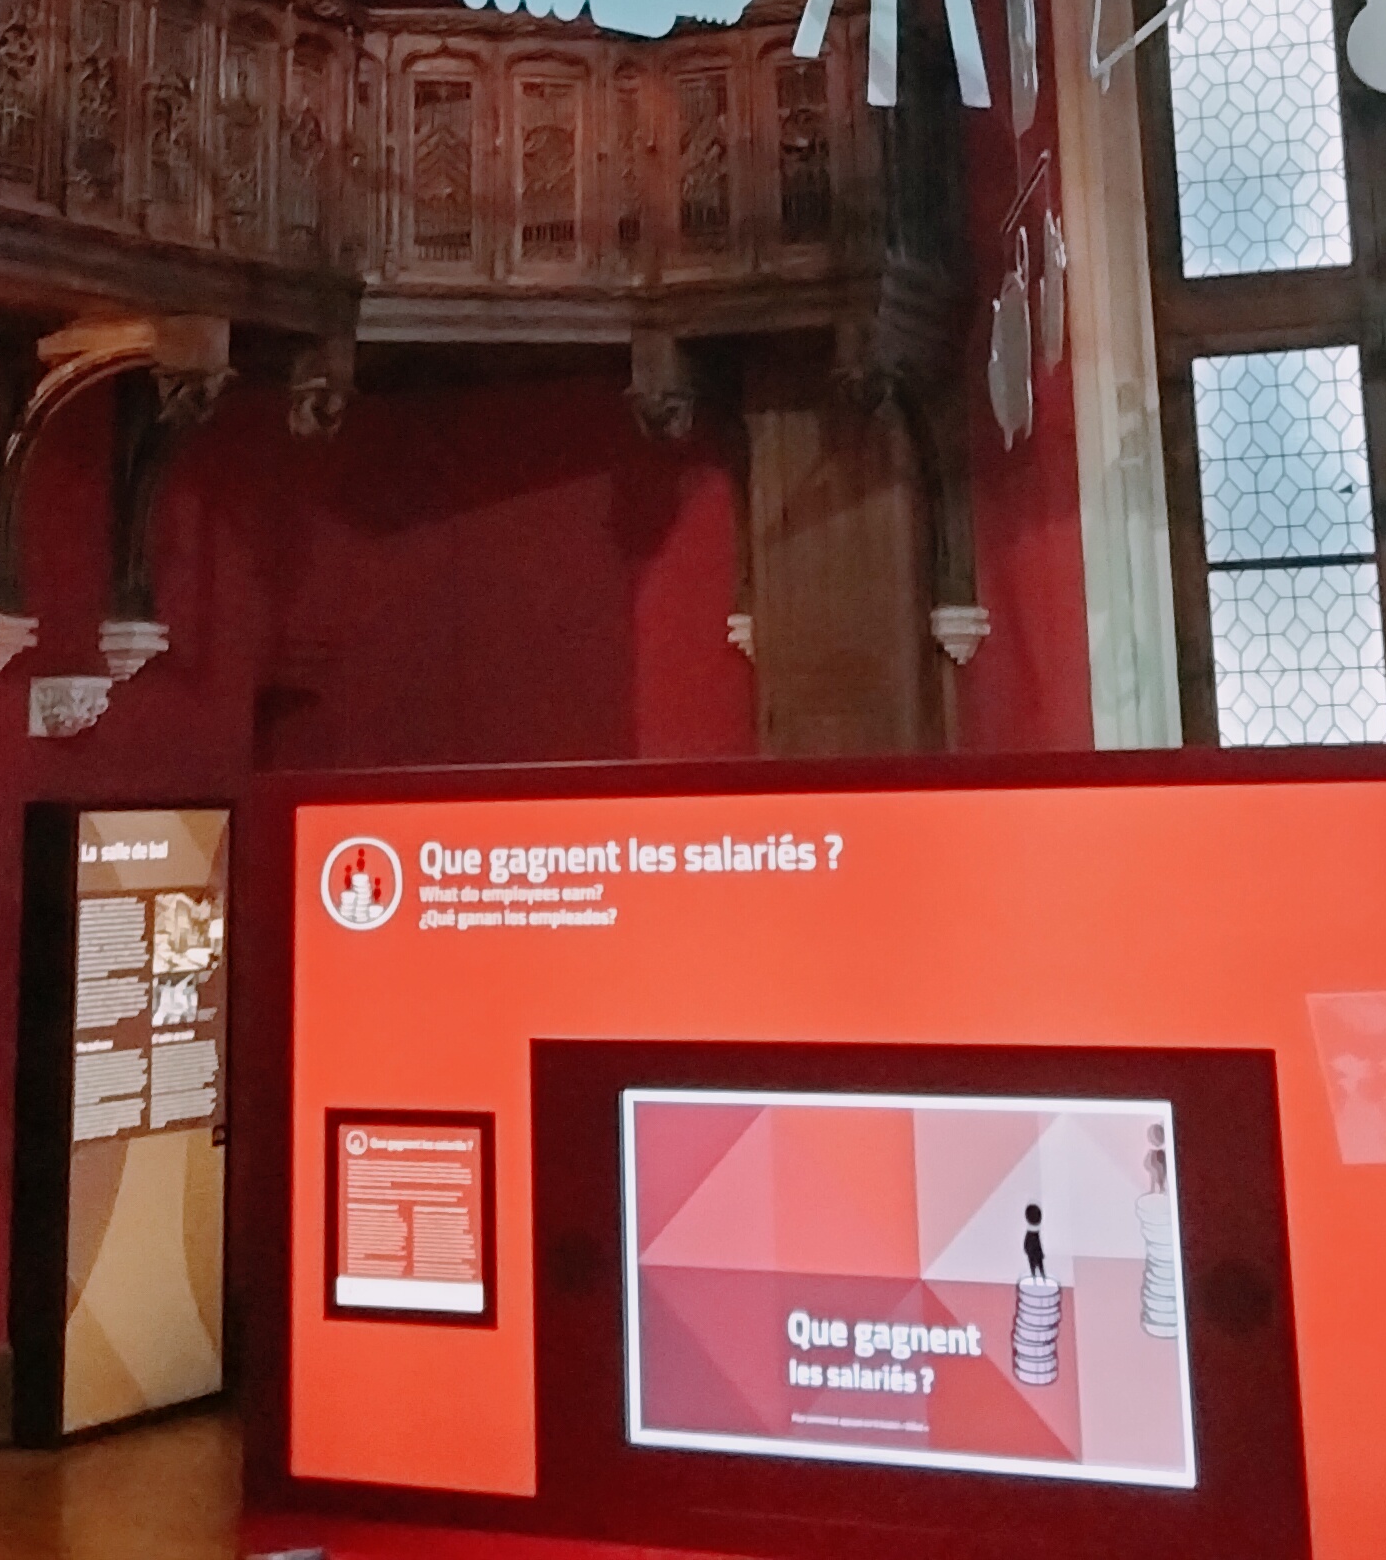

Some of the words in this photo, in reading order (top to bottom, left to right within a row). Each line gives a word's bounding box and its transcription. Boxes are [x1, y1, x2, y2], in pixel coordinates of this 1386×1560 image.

[420, 840, 483, 881] Que
[489, 839, 621, 883] gagnent
[628, 837, 677, 873] les
[684, 833, 817, 872] salariés
[824, 834, 844, 870] ?
[419, 885, 459, 903] What
[460, 885, 480, 902] do
[481, 884, 560, 906] employees
[561, 883, 605, 902] earn?
[457, 911, 503, 931] ganan
[503, 908, 527, 926] los
[528, 907, 618, 930] empleados?
[787, 1309, 848, 1352] Que
[854, 1321, 983, 1360] gagnent
[789, 1357, 824, 1387] les
[826, 1361, 918, 1395] salariés
[920, 1365, 936, 1395] ?
